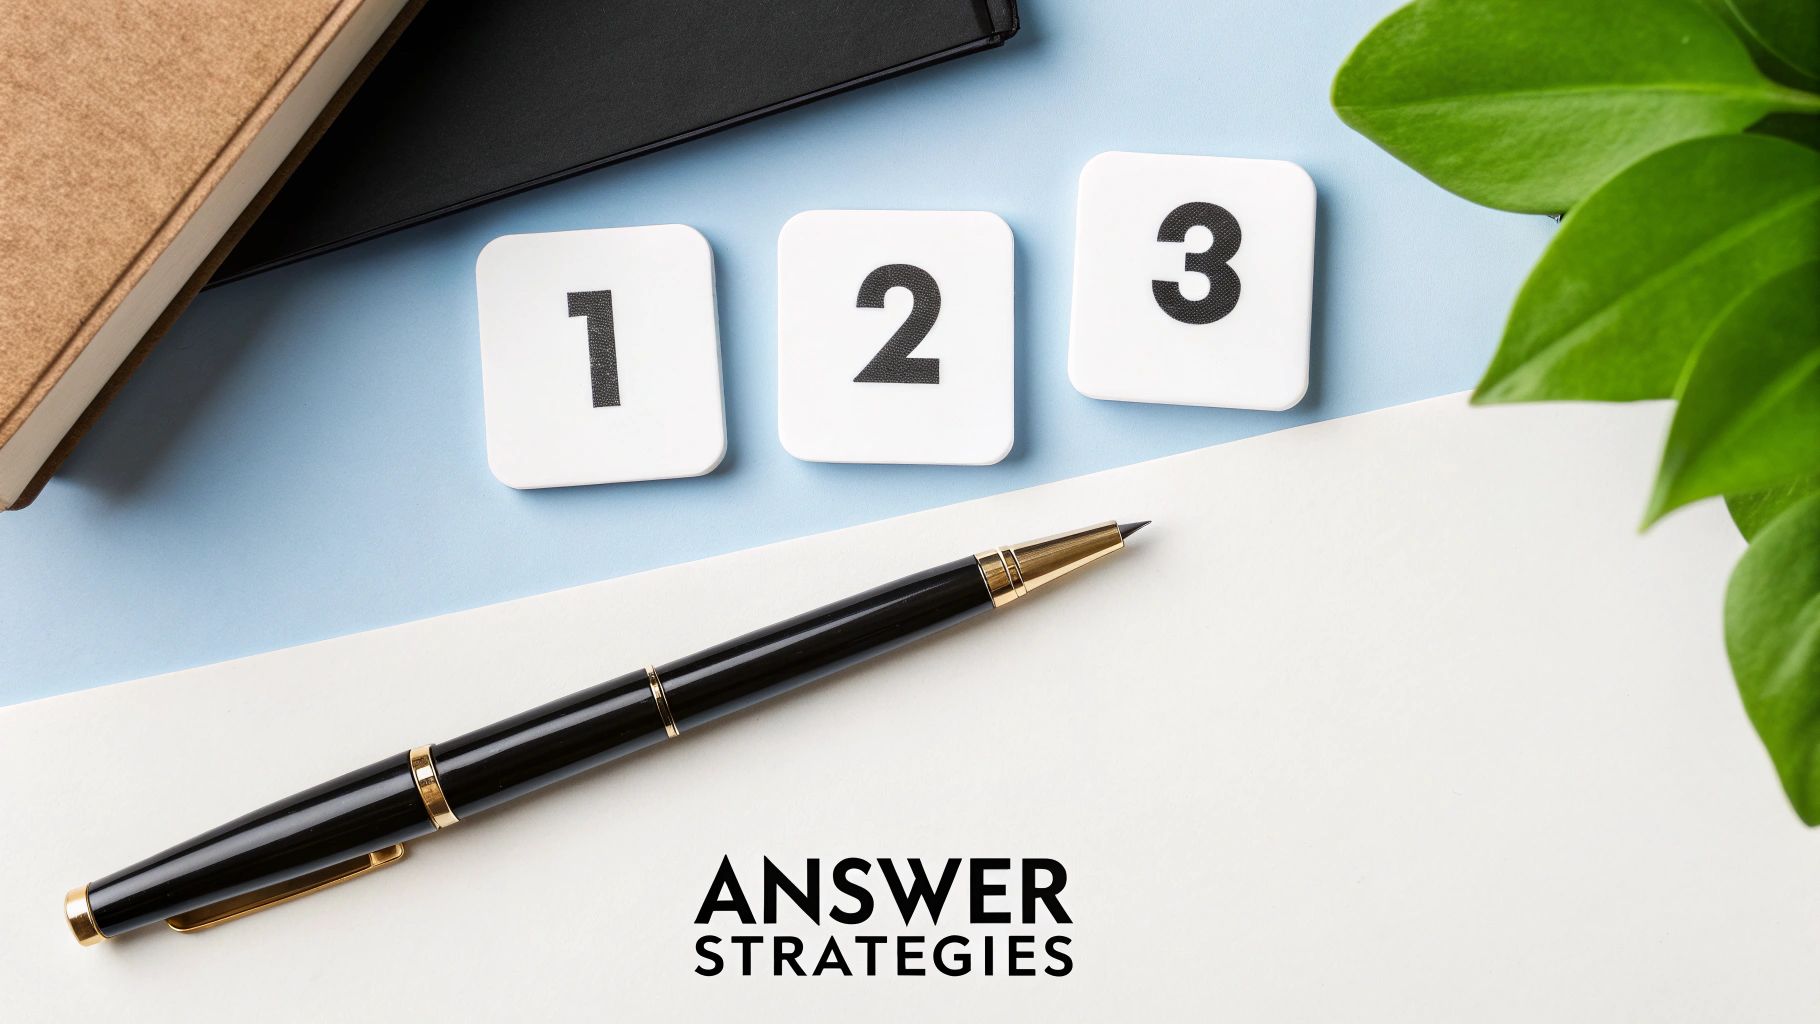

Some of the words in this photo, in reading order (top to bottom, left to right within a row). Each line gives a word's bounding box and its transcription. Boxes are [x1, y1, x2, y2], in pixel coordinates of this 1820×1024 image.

[853, 263, 941, 385] 2
[1151, 201, 1242, 325] 3
[567, 289, 620, 409] 1
